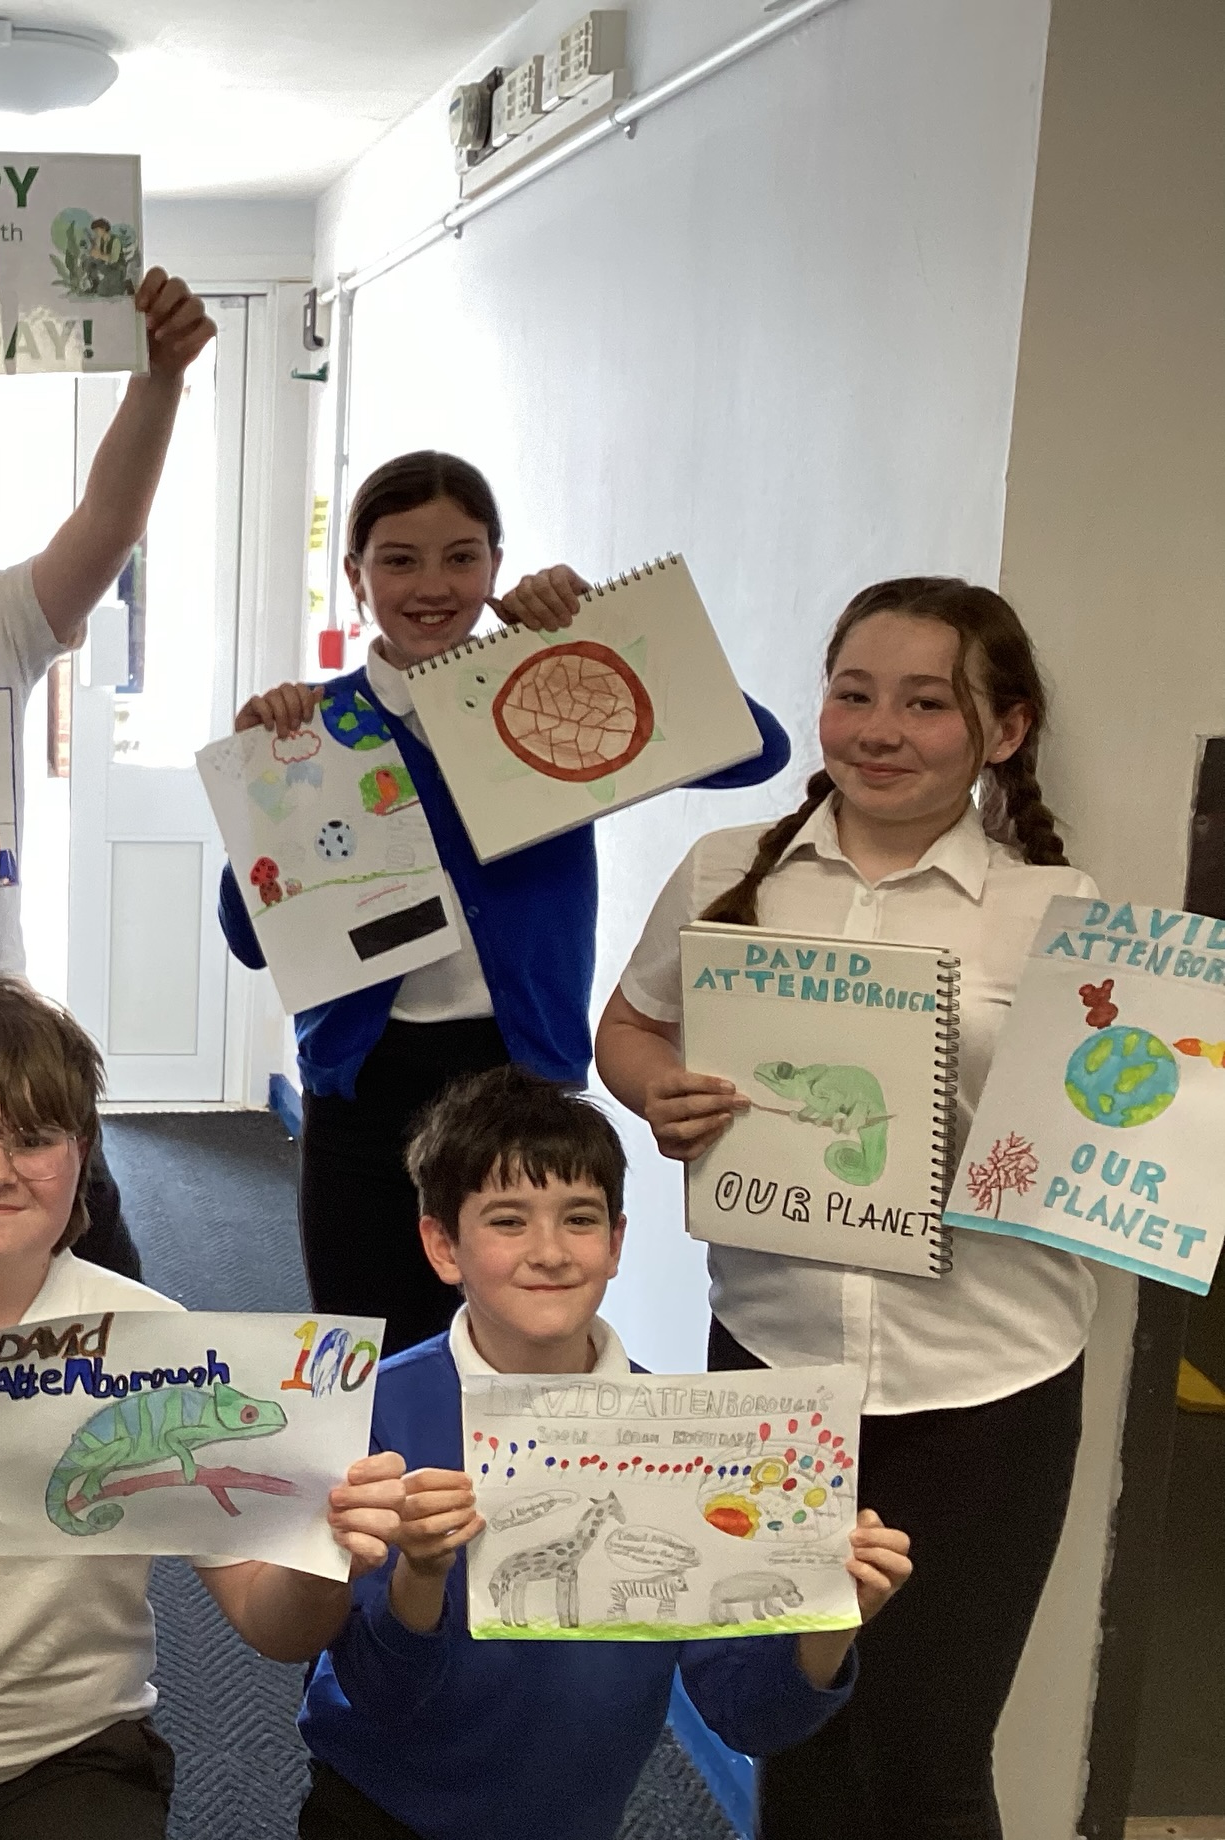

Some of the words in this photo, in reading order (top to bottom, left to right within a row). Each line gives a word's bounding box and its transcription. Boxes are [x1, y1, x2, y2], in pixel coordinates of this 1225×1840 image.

[1085, 900, 1225, 950] DAVID
[746, 944, 872, 976] DAVID
[693, 967, 937, 1013] ATTENBOROUGH
[1069, 1143, 1168, 1205] OUR
[715, 1171, 811, 1223] OUR
[827, 1191, 935, 1238] PLANET
[1043, 1176, 1208, 1260] PLANET
[280, 1320, 378, 1398] 100
[489, 1380, 622, 1418] DAVID
